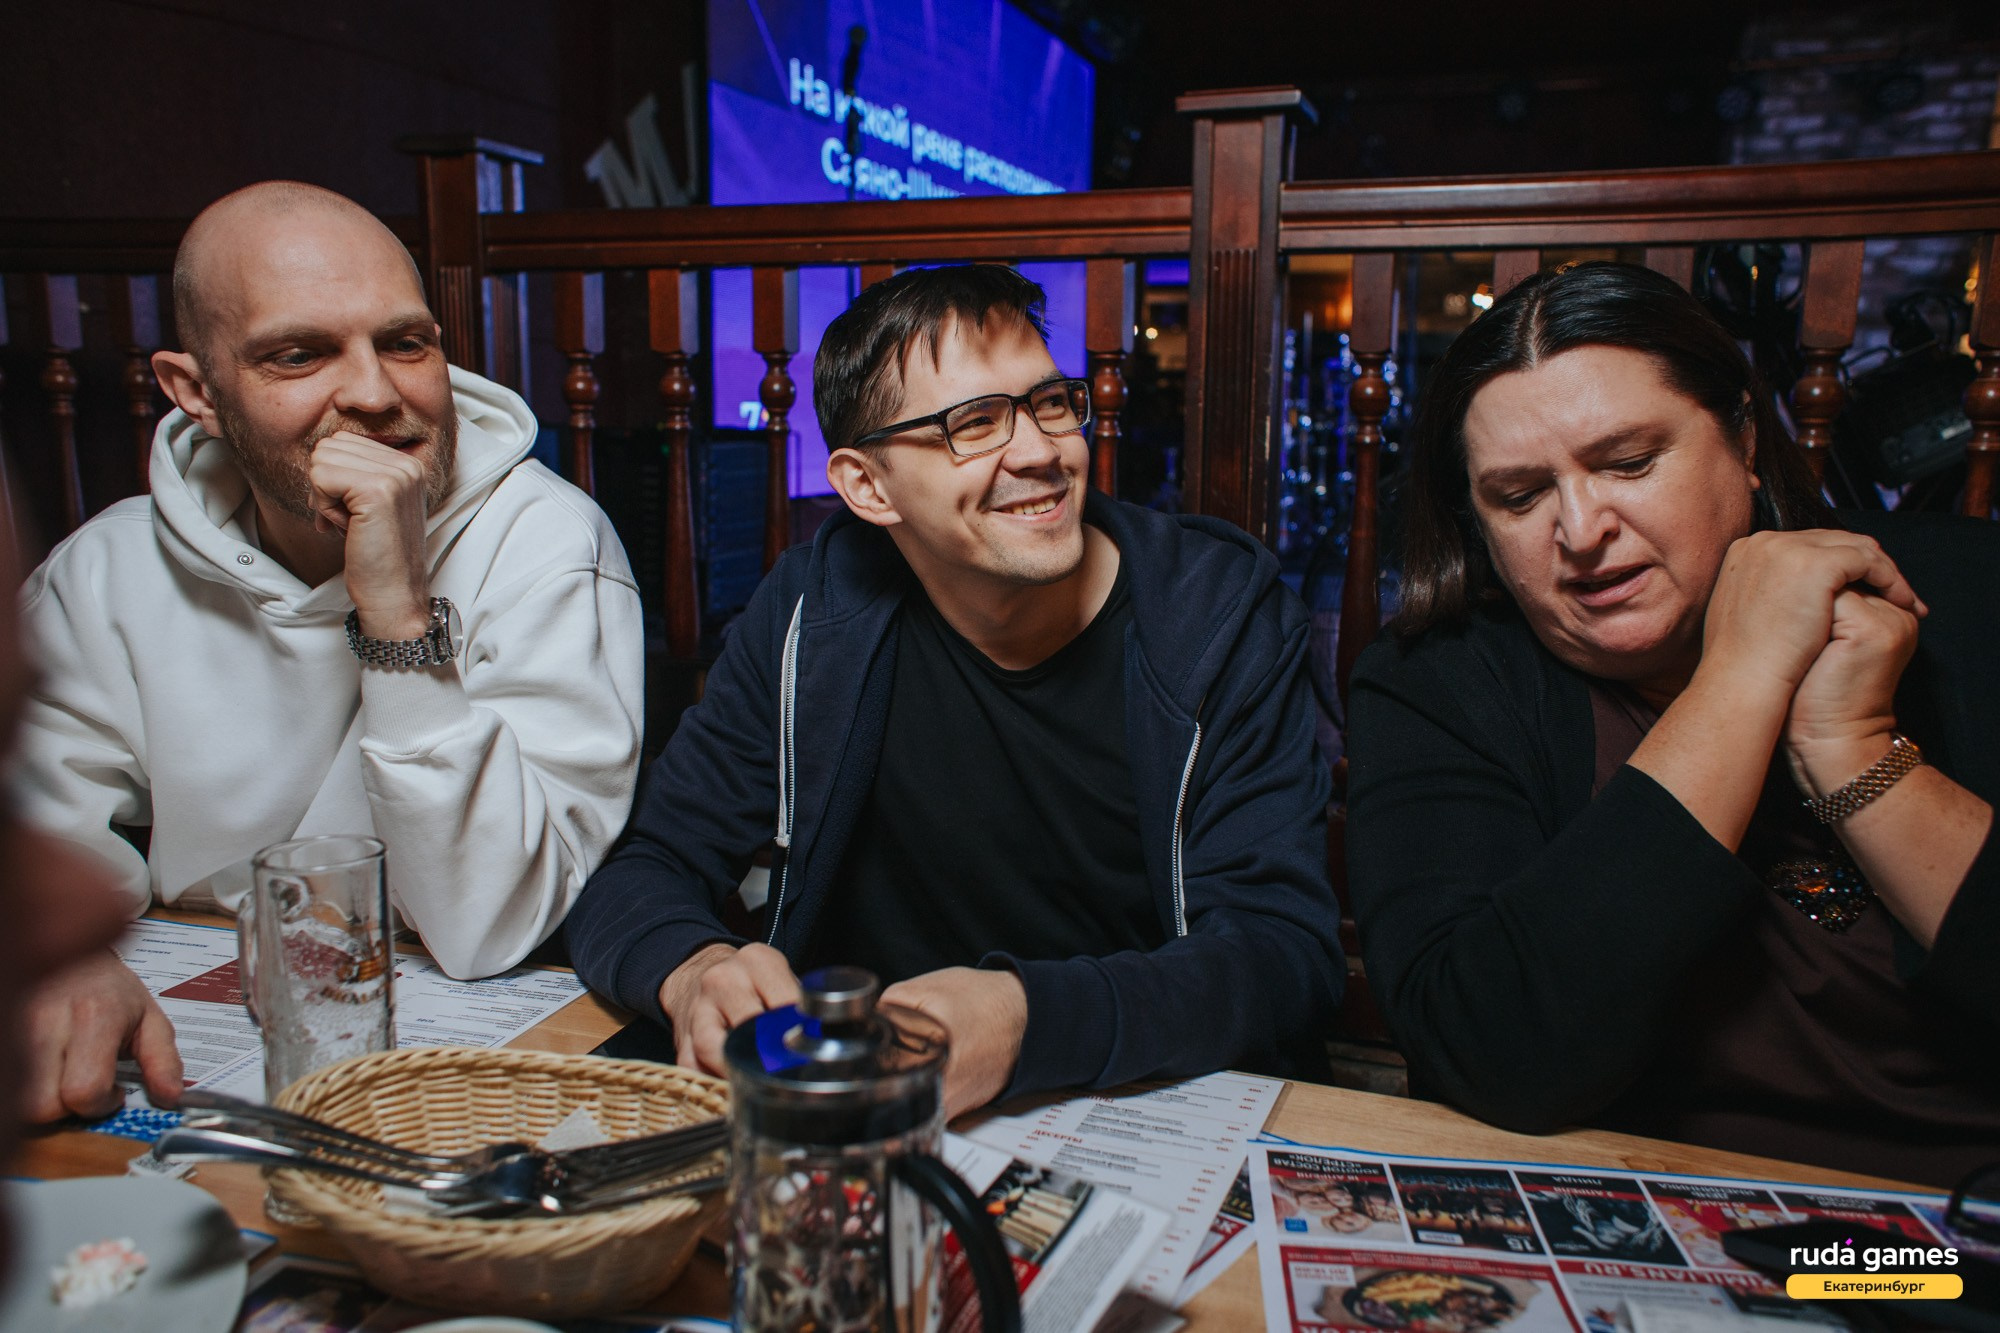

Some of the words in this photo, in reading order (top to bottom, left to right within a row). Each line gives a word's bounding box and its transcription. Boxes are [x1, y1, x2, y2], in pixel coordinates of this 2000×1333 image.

[789, 58, 832, 118] На
[911, 122, 963, 170] реке
[1273, 1158, 1321, 1170] СОСТАВ
